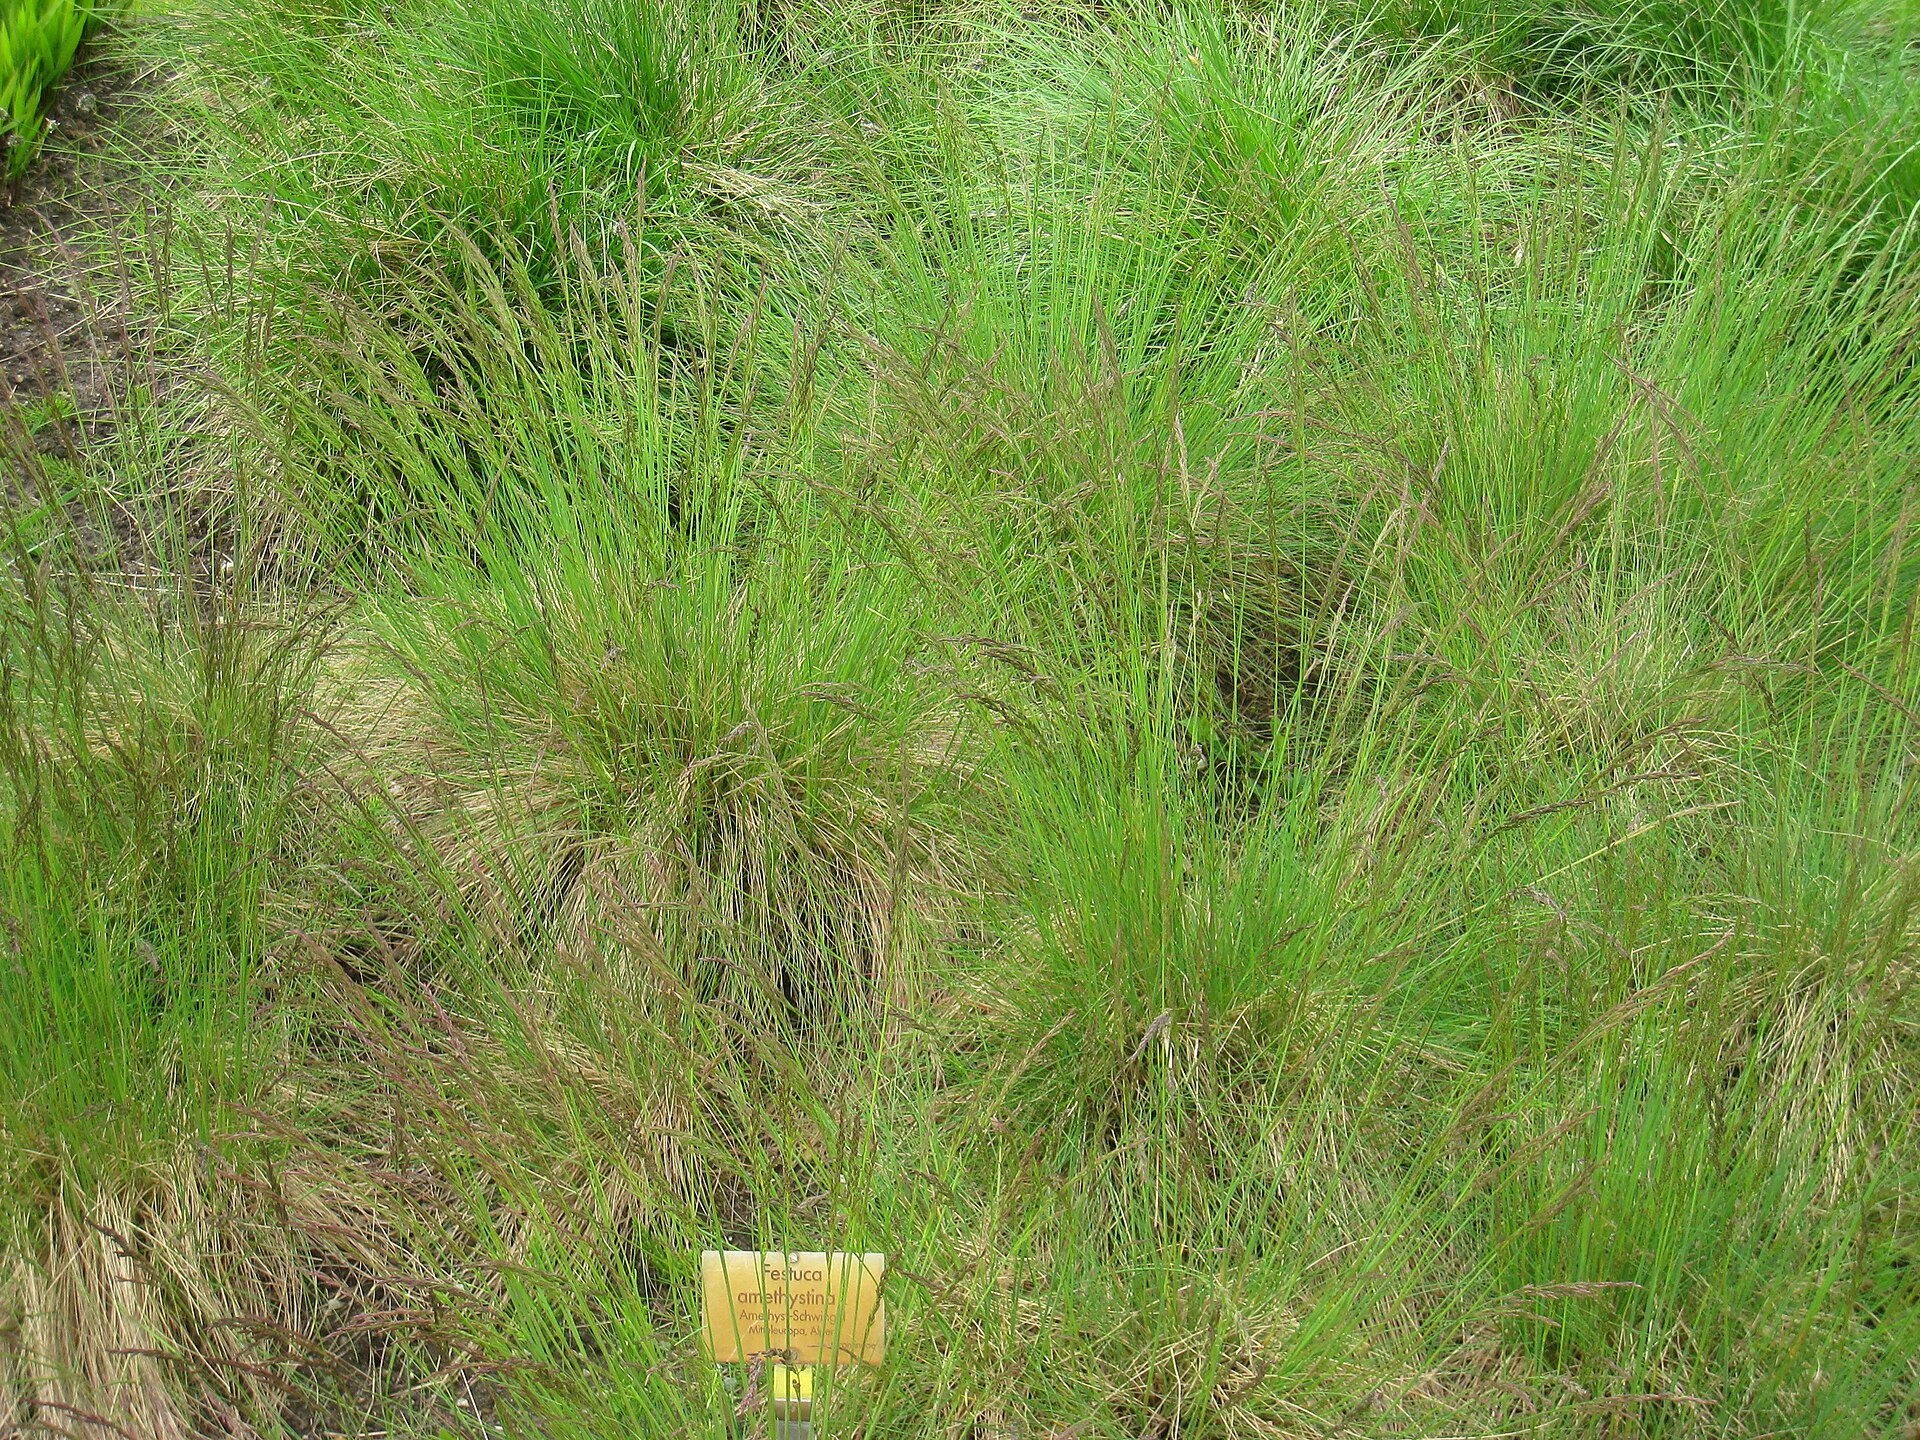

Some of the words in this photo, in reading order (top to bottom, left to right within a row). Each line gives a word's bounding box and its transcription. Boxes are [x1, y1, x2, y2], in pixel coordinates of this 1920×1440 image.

[763, 1263, 822, 1281] Festuca
[737, 1286, 836, 1309] amethystina
[739, 1309, 845, 1325] Amehys-Schwingl
